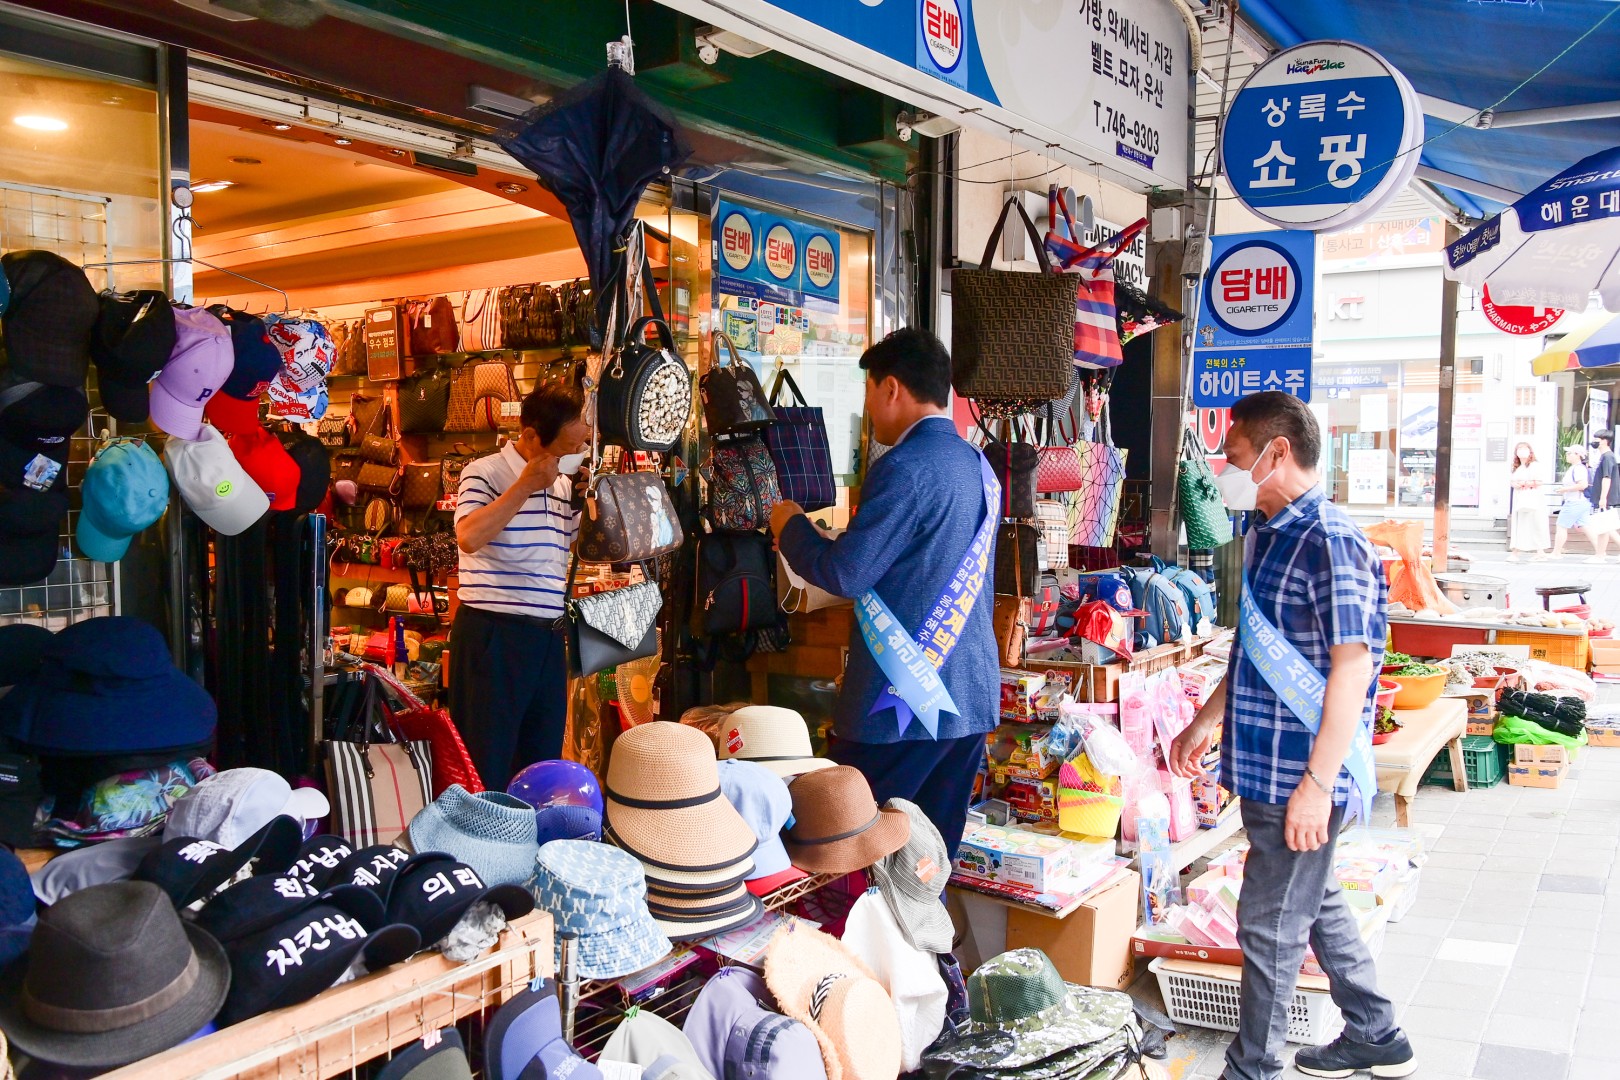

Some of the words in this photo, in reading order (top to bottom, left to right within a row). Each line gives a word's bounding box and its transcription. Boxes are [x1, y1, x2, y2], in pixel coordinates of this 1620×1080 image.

[926, 0, 958, 49] 담배
[930, 39, 954, 57] CIGARETTES
[1093, 100, 1159, 155] T.746-9303
[724, 227, 751, 255] 담배
[768, 238, 793, 265] 담배
[1323, 237, 1364, 252] 통사고
[808, 247, 833, 274] 담배
[1220, 265, 1288, 302] 담배
[1226, 304, 1279, 314] CIGARETTES
[1484, 303, 1525, 333] PHARMACY
[1231, 357, 1246, 369] 소주
[1200, 369, 1305, 397] 하이트소주
[949, 556, 975, 593] 다함께
[915, 595, 952, 650] 응원해주
[422, 867, 484, 902] 의리
